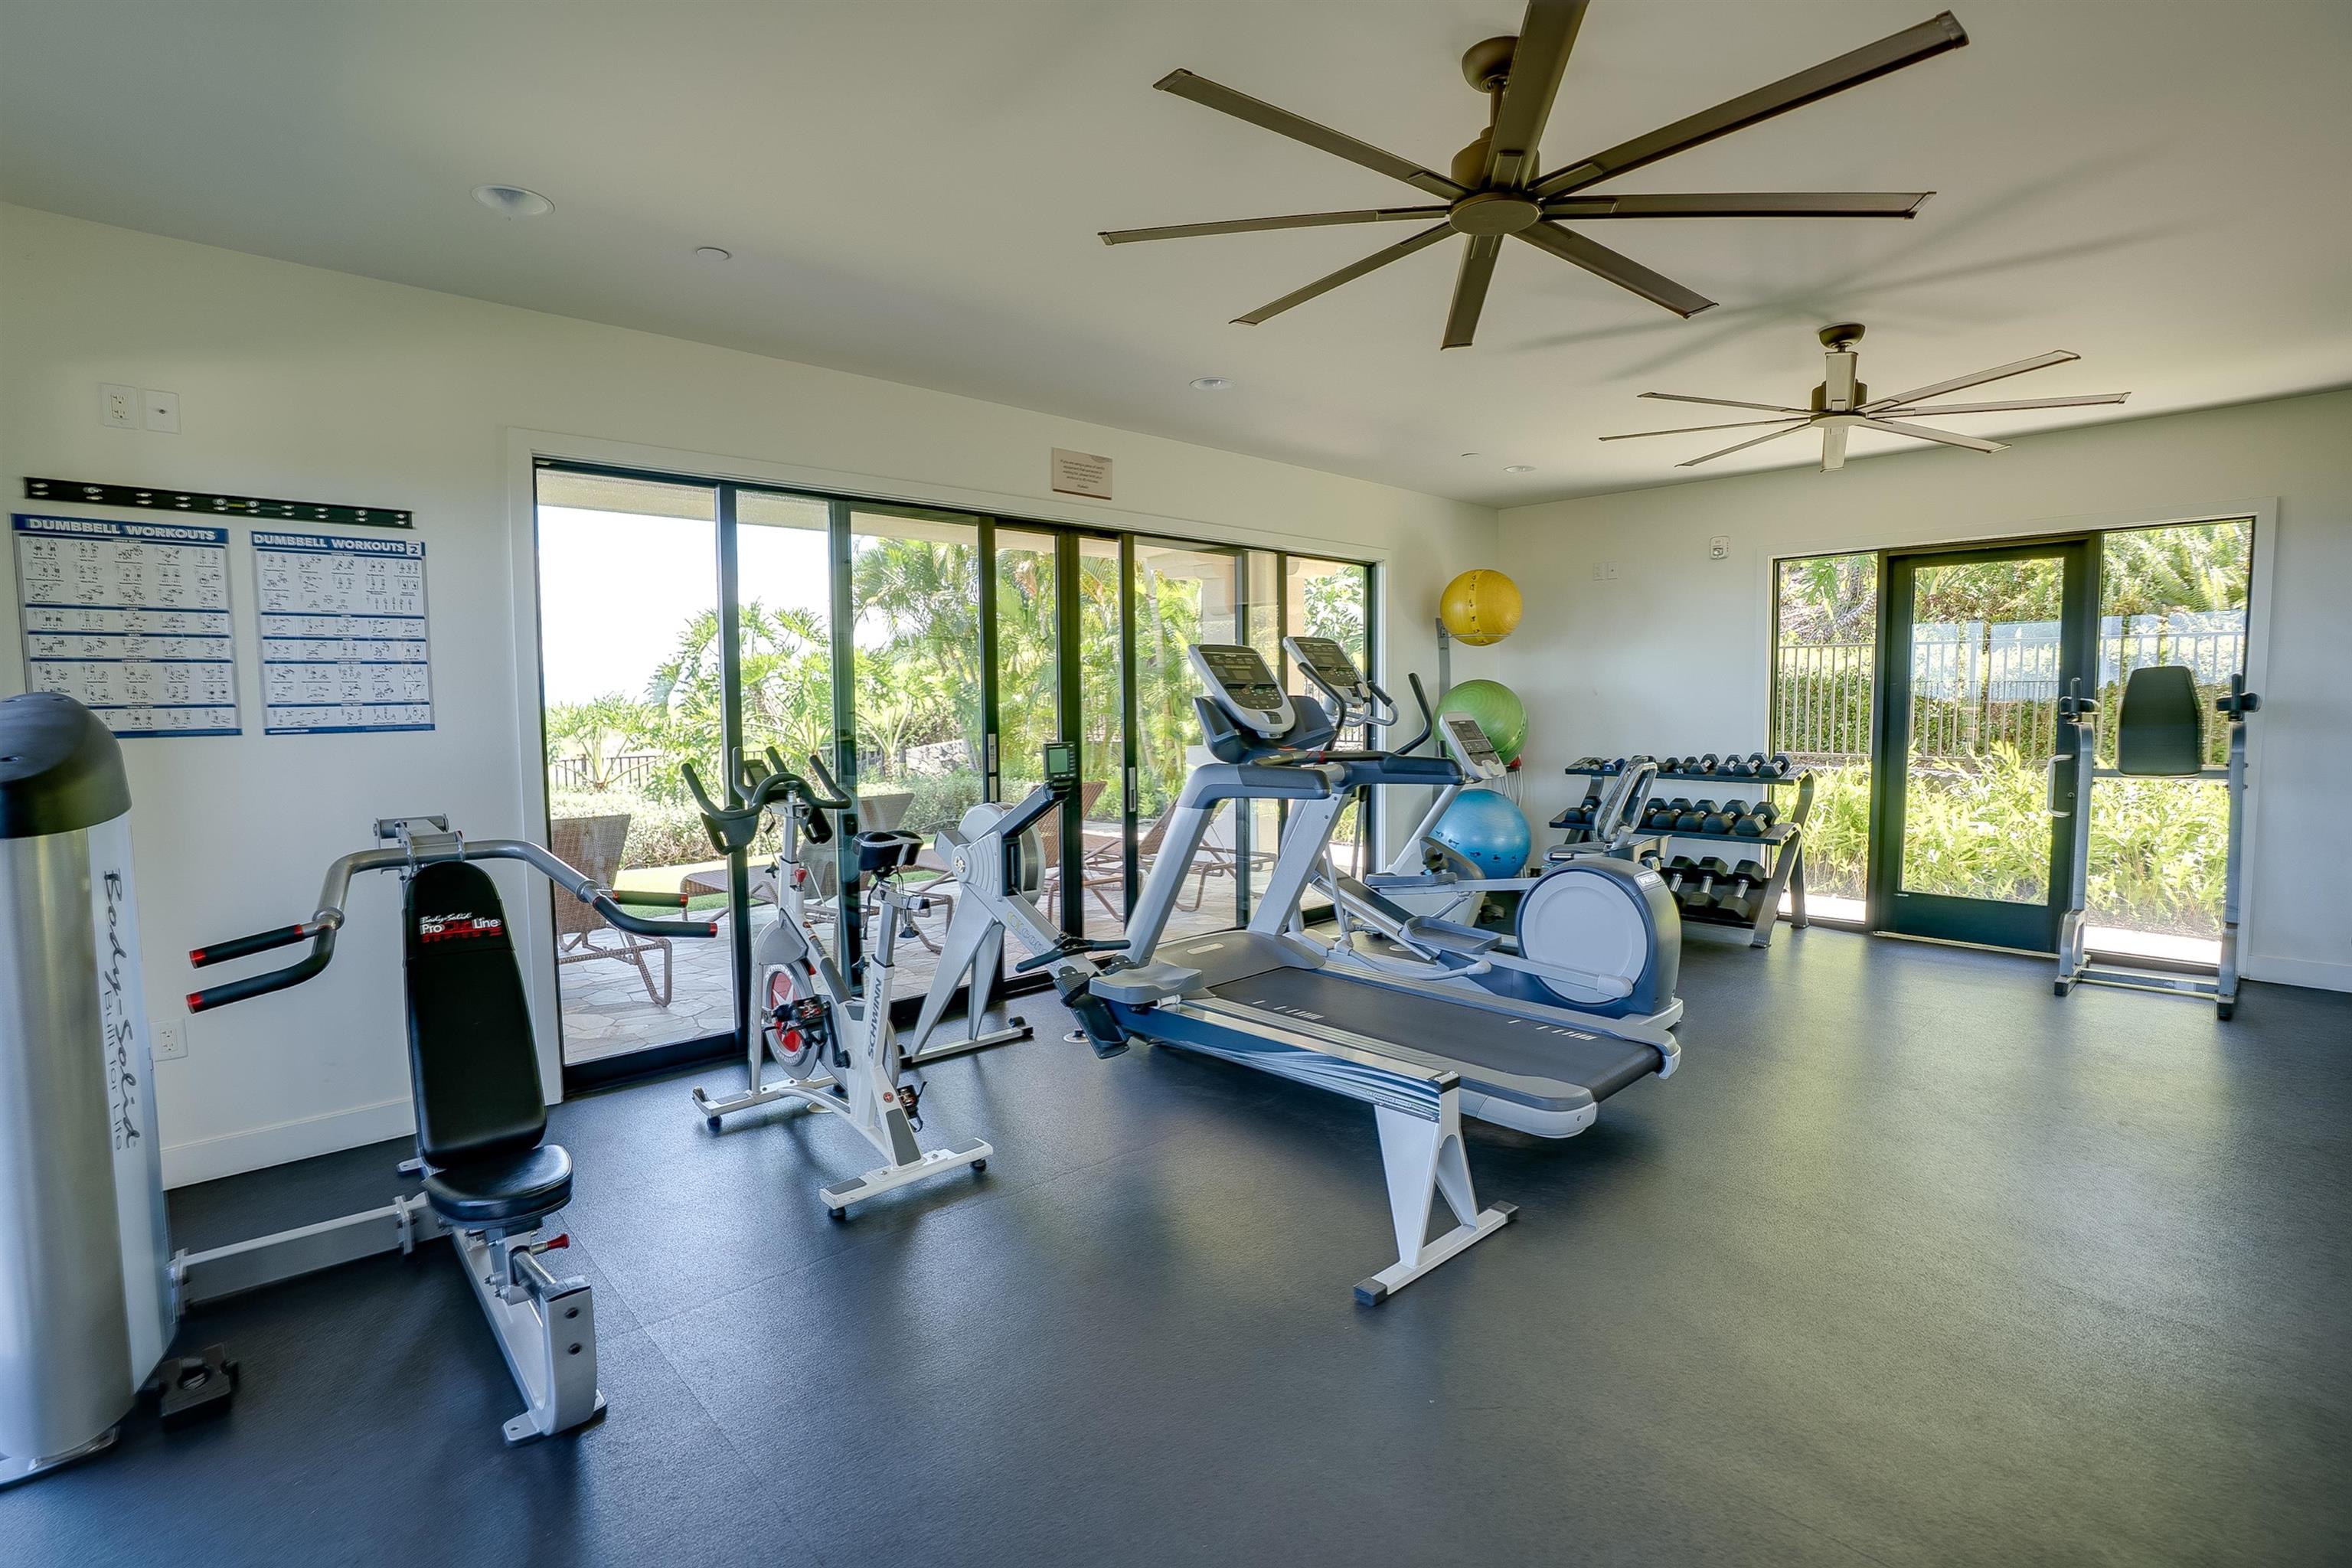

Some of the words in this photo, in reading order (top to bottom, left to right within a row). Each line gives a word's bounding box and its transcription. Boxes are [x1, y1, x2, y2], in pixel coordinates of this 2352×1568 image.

[28, 518, 121, 534] DUMBBELL
[124, 525, 216, 541] WORKOUTS
[253, 534, 328, 548] DUMBBELL
[331, 539, 405, 552] WORKOUTS
[410, 546, 419, 554] 2
[104, 868, 140, 1148] Body-Solid
[867, 978, 881, 1060] SCHWINN
